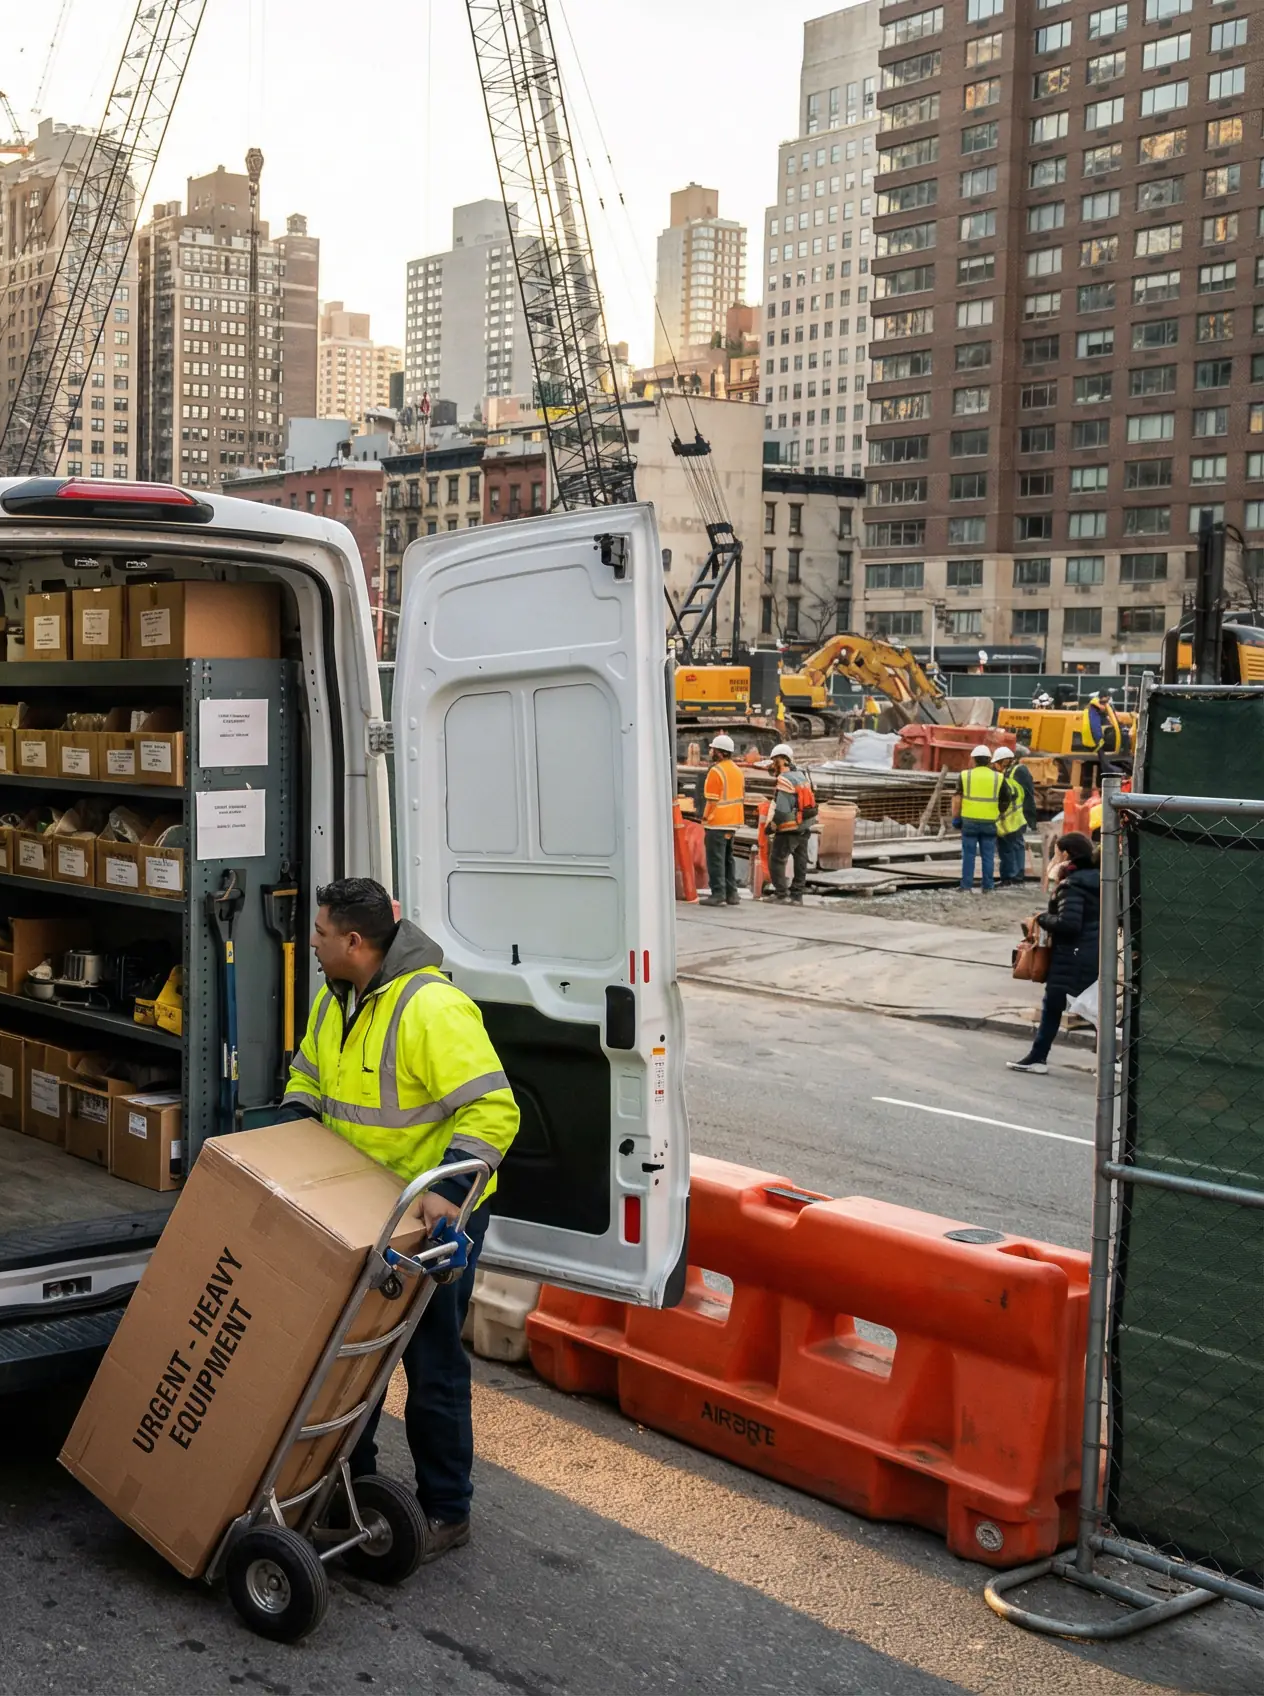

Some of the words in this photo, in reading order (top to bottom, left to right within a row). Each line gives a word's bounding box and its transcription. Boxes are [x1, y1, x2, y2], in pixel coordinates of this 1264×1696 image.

[132, 1348, 192, 1454] URGENT
[188, 1246, 243, 1337] HEAVY
[168, 1297, 252, 1451] EQUIPMENT
